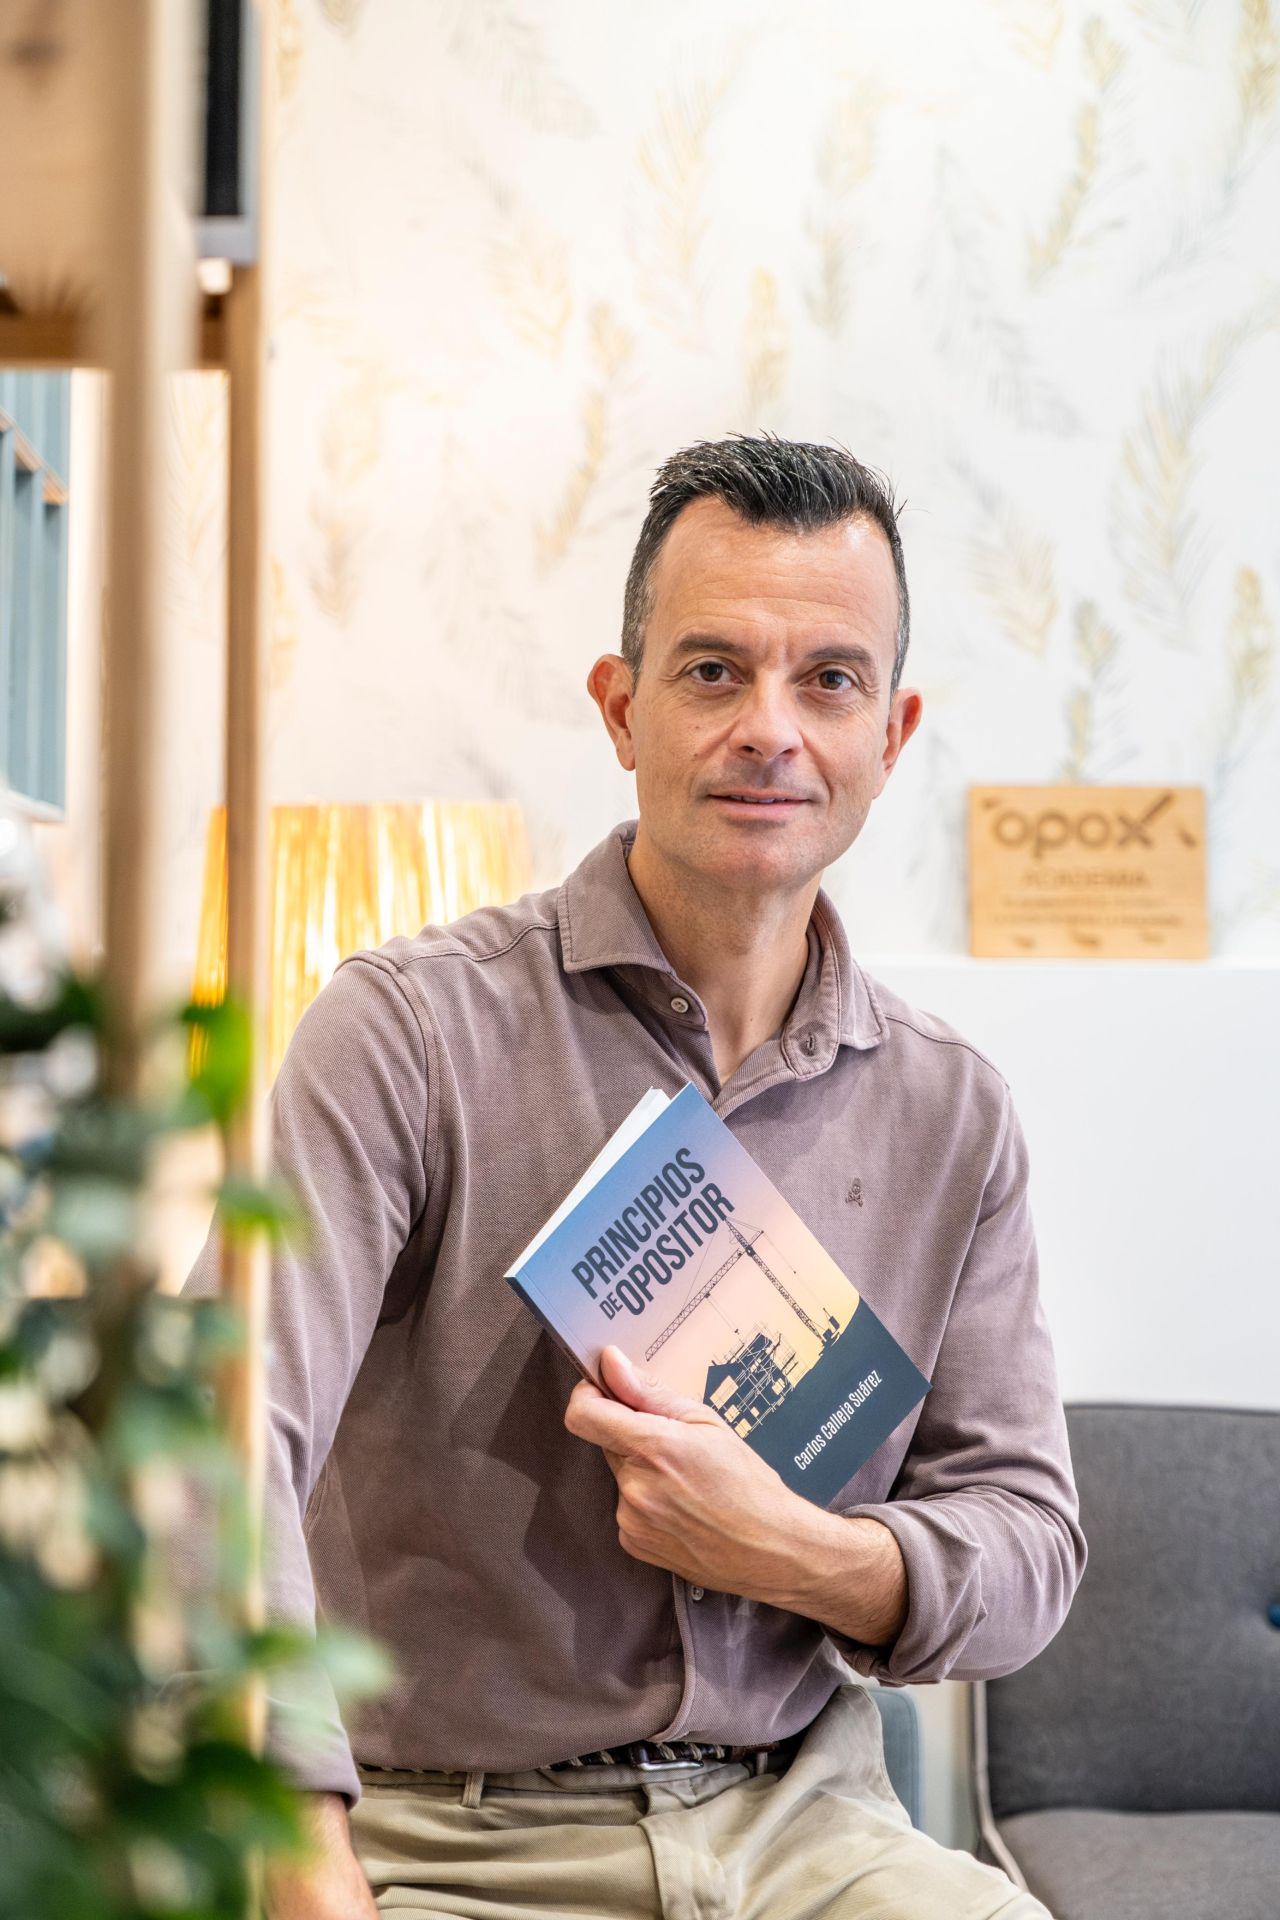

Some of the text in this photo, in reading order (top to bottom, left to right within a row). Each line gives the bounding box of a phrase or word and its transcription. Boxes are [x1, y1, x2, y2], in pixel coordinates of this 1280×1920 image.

[571, 1148, 705, 1300] PRINCIPIOS
[599, 1183, 735, 1320] DE OPOSITOR
[794, 1369, 883, 1471] Carlos Calleja Suárez
